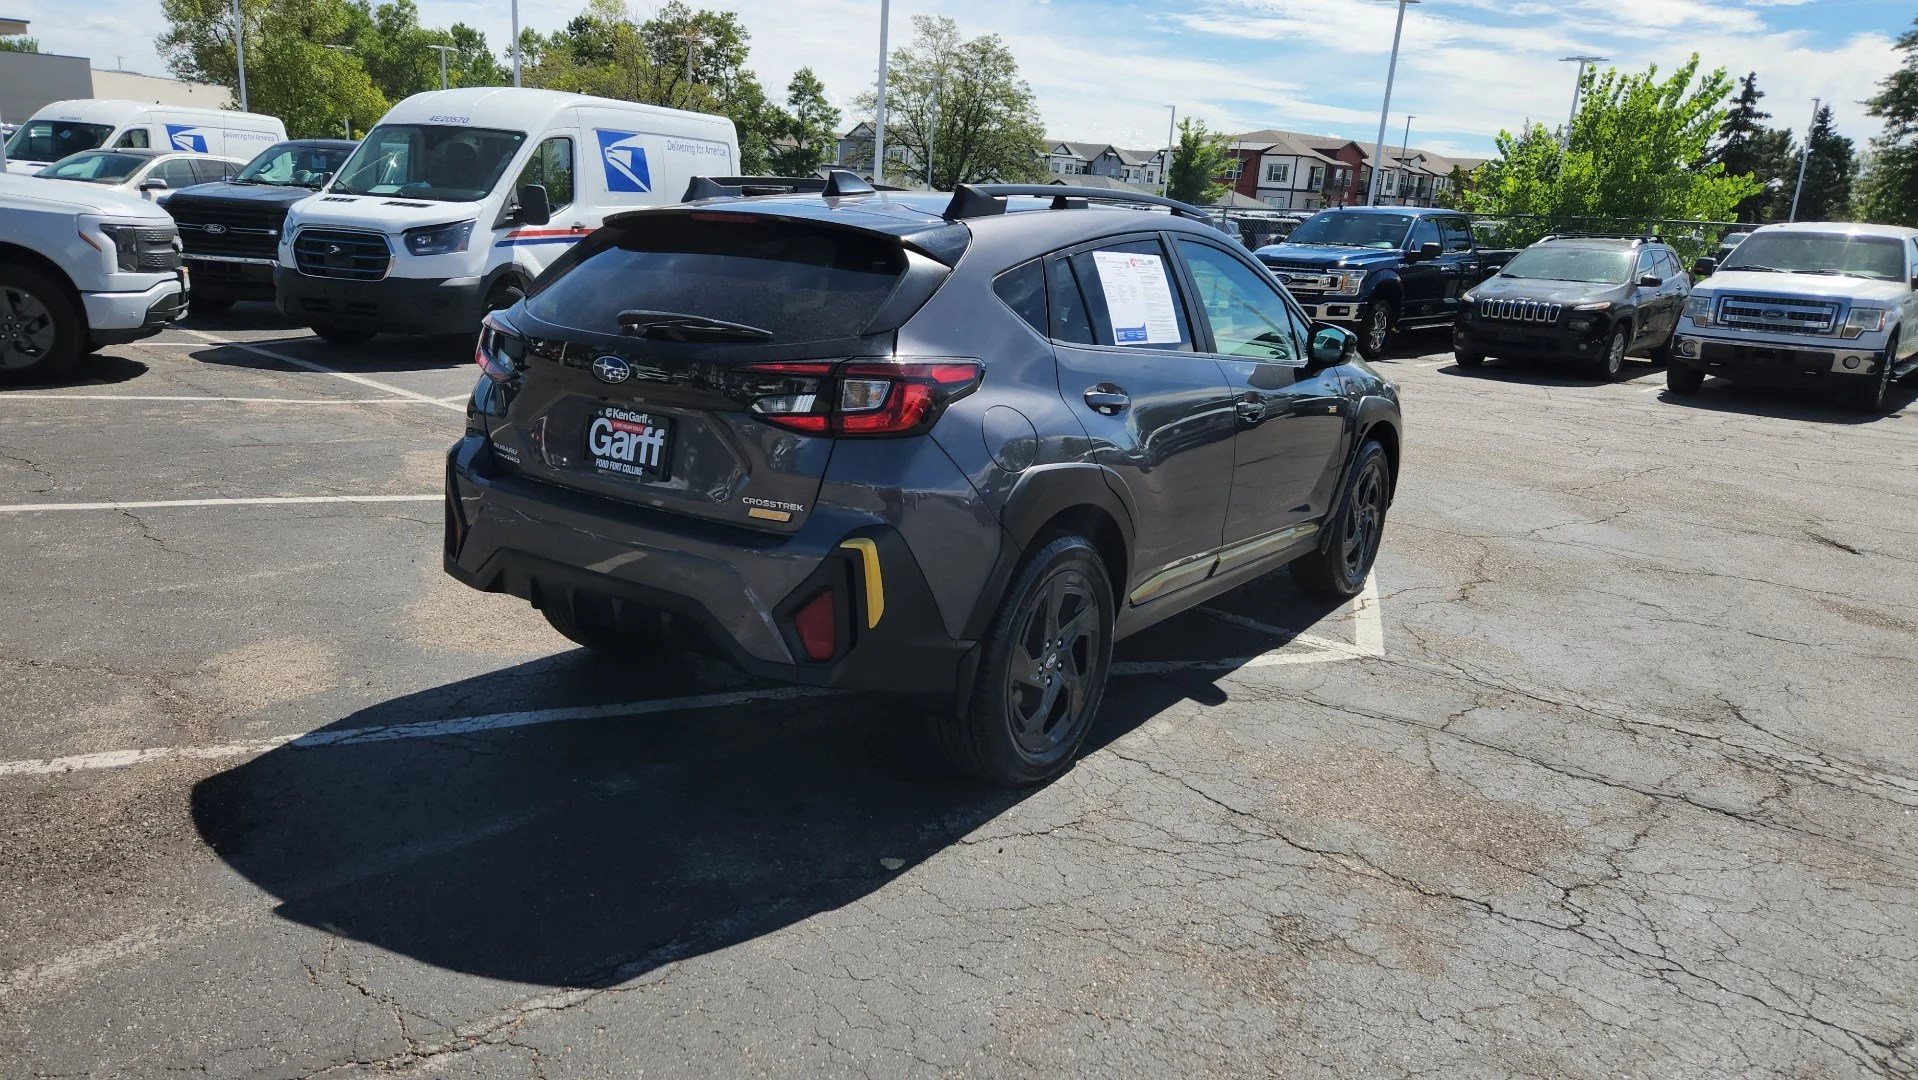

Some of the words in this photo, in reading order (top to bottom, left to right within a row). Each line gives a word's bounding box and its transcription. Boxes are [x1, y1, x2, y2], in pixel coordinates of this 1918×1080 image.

[429, 115, 470, 124] 4E20570
[666, 140, 696, 156] Delivering
[696, 143, 704, 154] for
[704, 145, 726, 157] America
[612, 408, 628, 420] Ken
[629, 411, 648, 424] Garff
[493, 442, 518, 455] SUBARU
[589, 417, 665, 466] Garff
[595, 458, 609, 469] FORD
[609, 461, 622, 472] FORT
[622, 463, 643, 476] COLLINS
[742, 496, 804, 512] CROSSTREK
